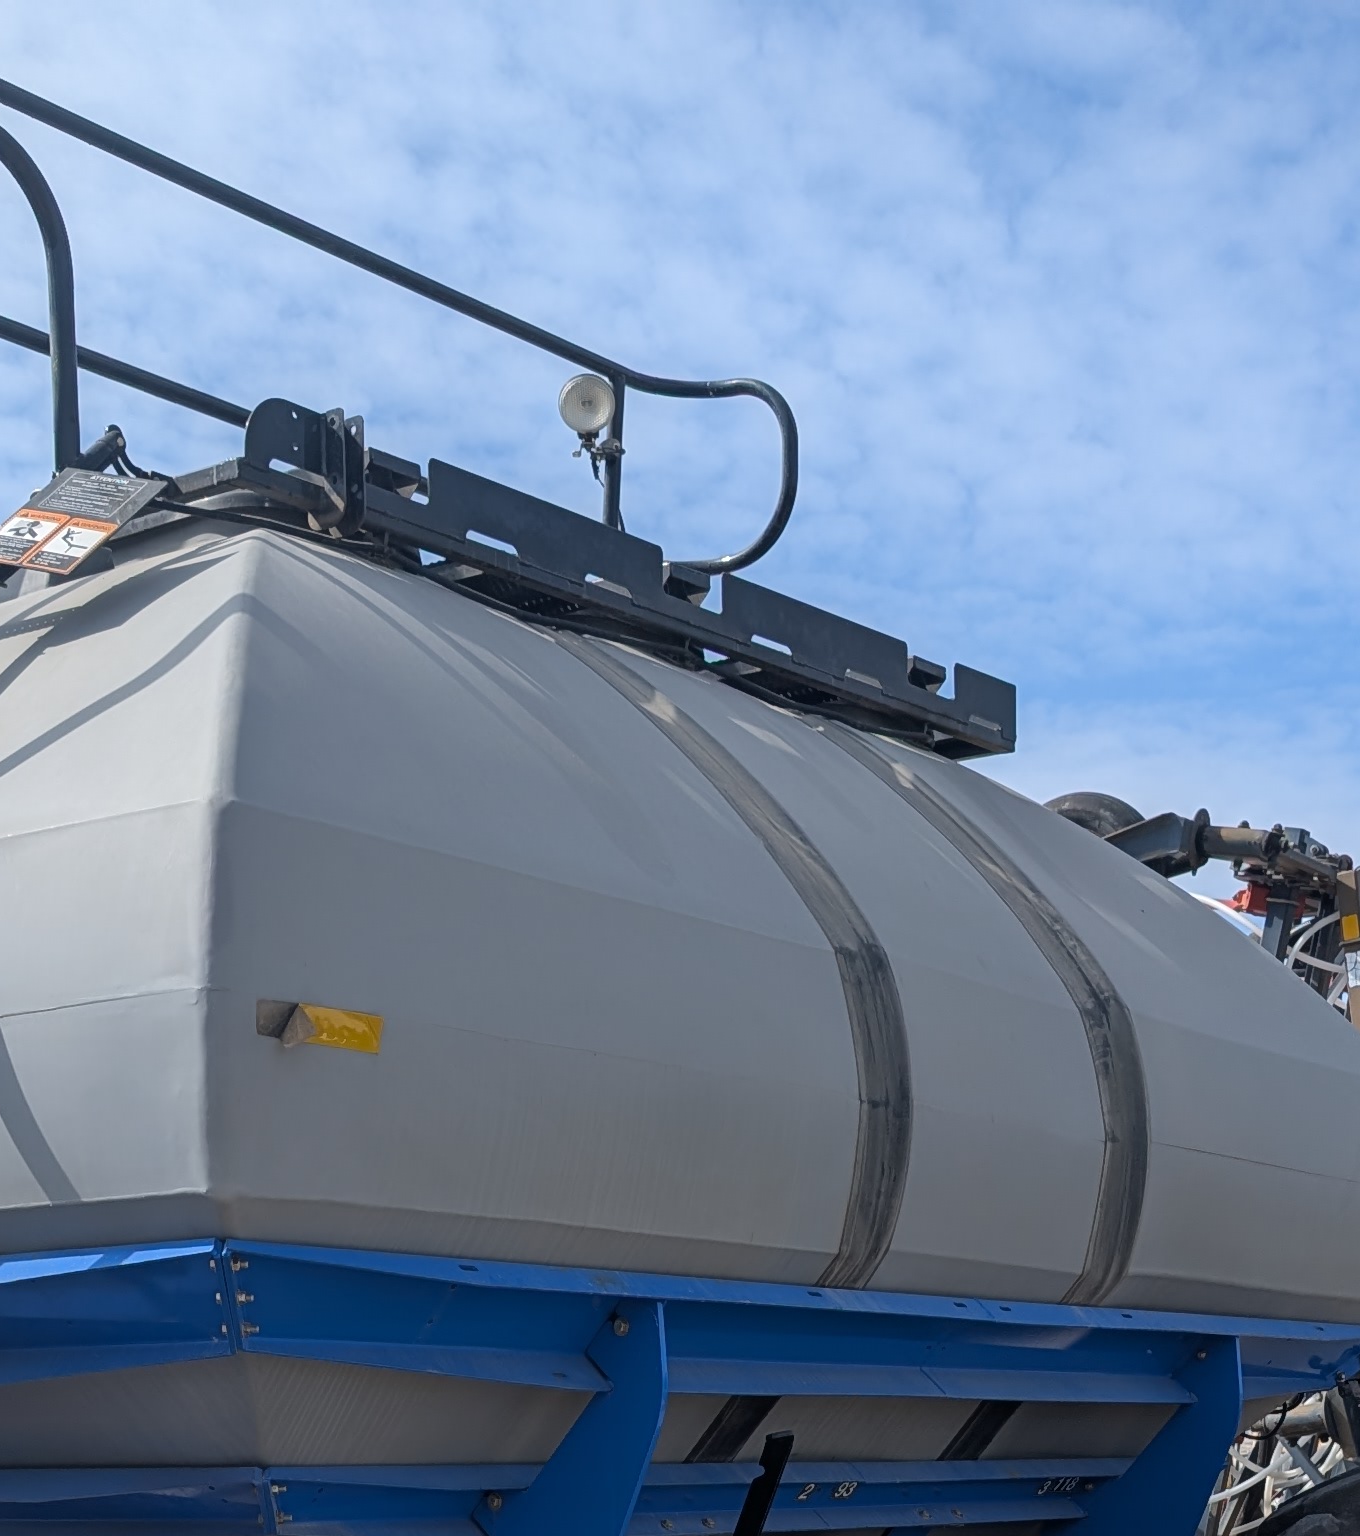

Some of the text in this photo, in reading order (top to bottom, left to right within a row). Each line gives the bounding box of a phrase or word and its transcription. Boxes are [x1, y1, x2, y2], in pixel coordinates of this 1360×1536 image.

[797, 1481, 858, 1500] 2 93
[1037, 1476, 1080, 1495] 3 118
